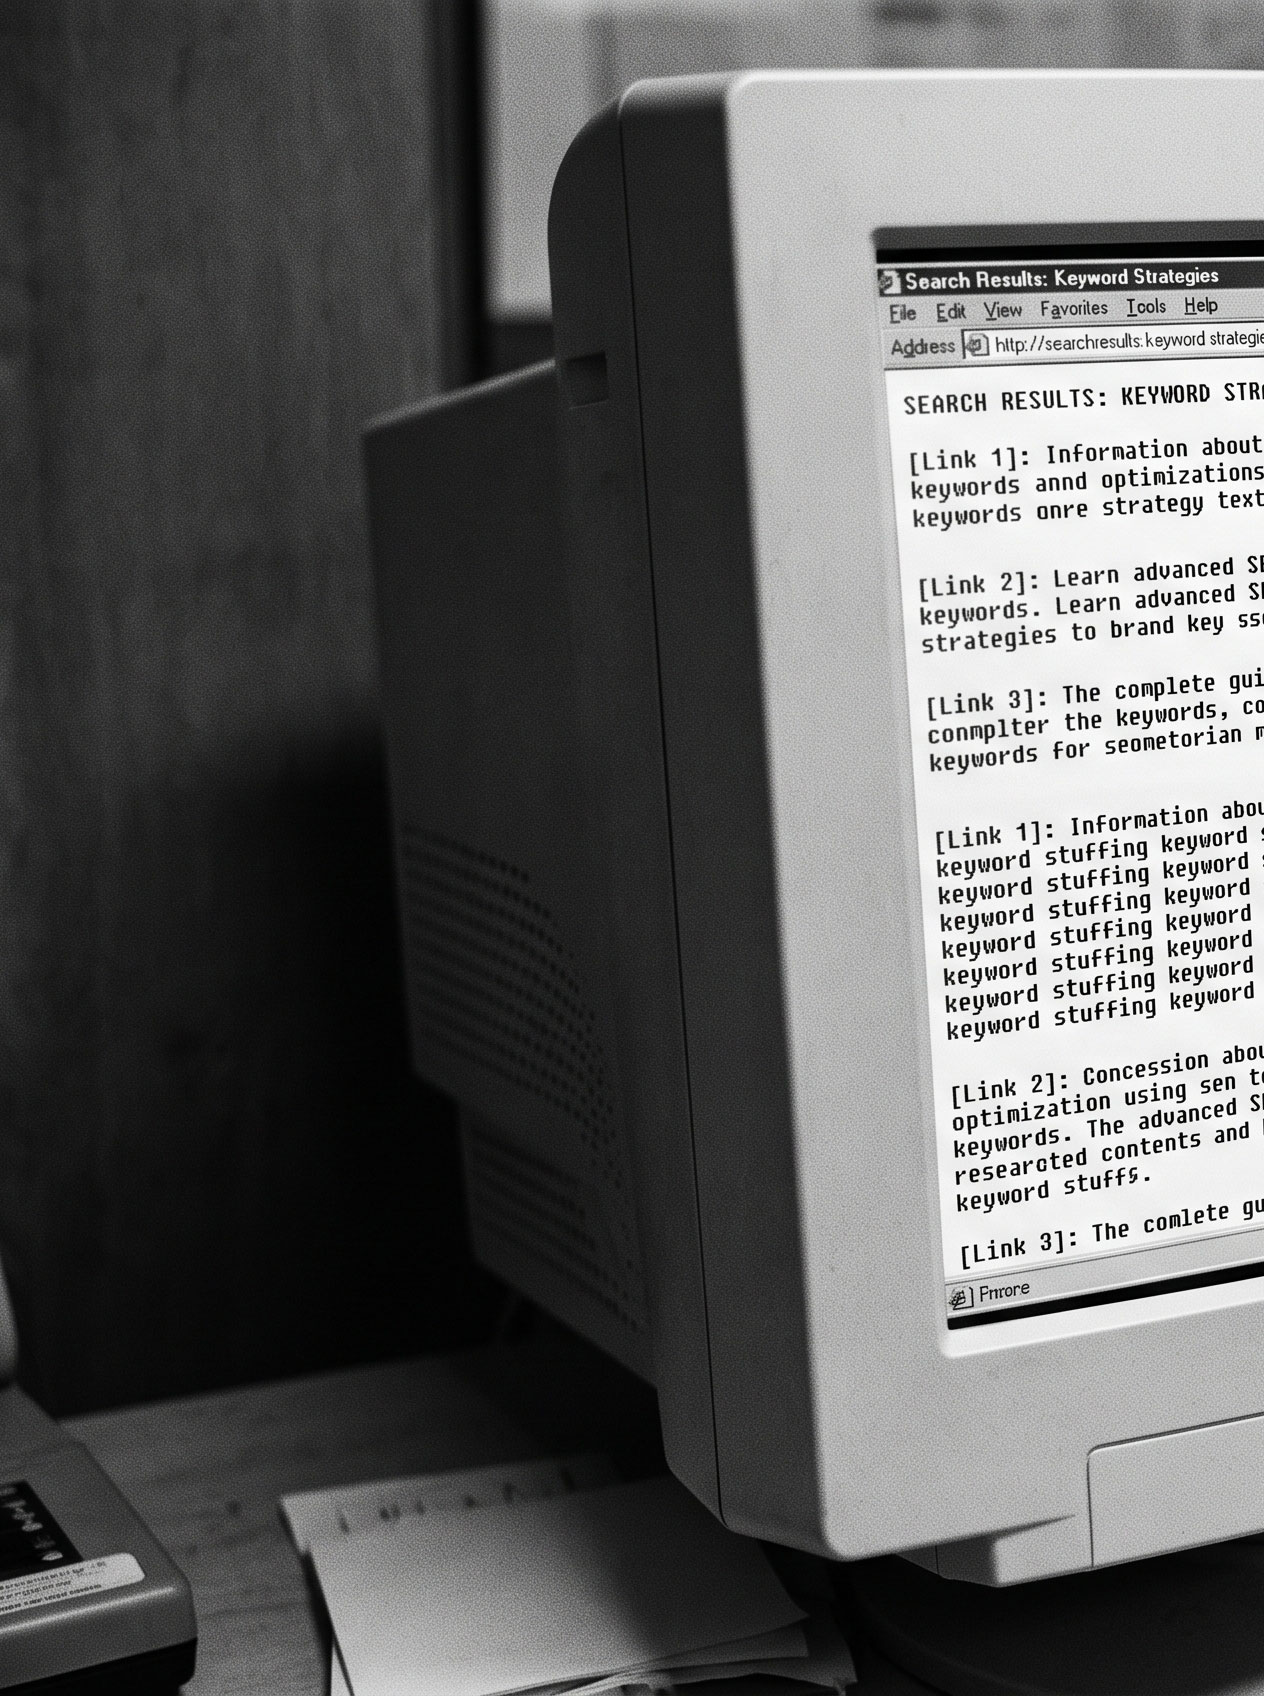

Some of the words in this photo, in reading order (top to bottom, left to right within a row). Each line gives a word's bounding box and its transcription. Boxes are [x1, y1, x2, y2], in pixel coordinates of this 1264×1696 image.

[905, 272, 971, 291] Search
[976, 270, 1048, 288] Results:
[1054, 268, 1129, 289] Keyword
[1133, 267, 1219, 286] Strategies
[889, 304, 917, 324] File
[936, 303, 967, 322] Edit
[983, 301, 1023, 321] View
[1041, 300, 1109, 319] Favorites
[1126, 297, 1167, 317] Tools
[1184, 297, 1218, 315] Help
[891, 338, 956, 358] Address
[903, 391, 987, 415] SEARCH
[1000, 387, 1106, 411] RESULTS:
[1120, 382, 1211, 406] KEYWORD
[909, 447, 977, 477] [Link
[990, 446, 1029, 472] 1]:
[1046, 437, 1188, 464] Information
[1200, 433, 1263, 456] about
[910, 474, 1020, 504] keywords
[1100, 461, 1264, 494] optimizations
[912, 502, 1022, 532] keywords
[1101, 493, 1204, 517] strategy
[918, 573, 986, 603] [Link
[999, 570, 1038, 596] 2]:
[1052, 567, 1119, 588] Learn
[1132, 555, 1234, 582] advanced
[921, 623, 1057, 654] strategies
[1070, 622, 1096, 642] to
[1109, 614, 1175, 639] brand
[1186, 612, 1224, 636] key
[927, 691, 994, 722] [Link
[1007, 687, 1046, 714] 3]:
[1061, 683, 1101, 704] The
[1113, 673, 1215, 702] complete
[1063, 710, 1102, 732] the
[928, 743, 1038, 775] keywords
[1051, 739, 1090, 760] for
[934, 824, 1002, 856] [Link
[1015, 819, 1053, 846] 1]:
[1070, 803, 1209, 837] Information
[935, 848, 1031, 881] keyword
[1044, 836, 1148, 866] stuffing
[1160, 824, 1248, 856] keyword
[946, 1009, 1040, 1043] keyword
[1053, 995, 1157, 1027] stuffing
[1168, 979, 1255, 1013] keyword
[951, 1077, 1017, 1110] [Link
[1030, 1071, 1068, 1097] 2]:
[1082, 1051, 1209, 1086] Concession
[951, 1092, 1111, 1135] optimization
[1123, 1081, 1187, 1106] using
[1199, 1074, 1236, 1095] sen
[952, 1126, 1071, 1161] keywords.
[1085, 1117, 1125, 1138] The
[1137, 1096, 1237, 1130] advanced
[955, 1178, 1050, 1214] keyword
[960, 1236, 1026, 1270] [Link
[1039, 1229, 1077, 1255] 3]:
[1091, 1221, 1130, 1242] The
